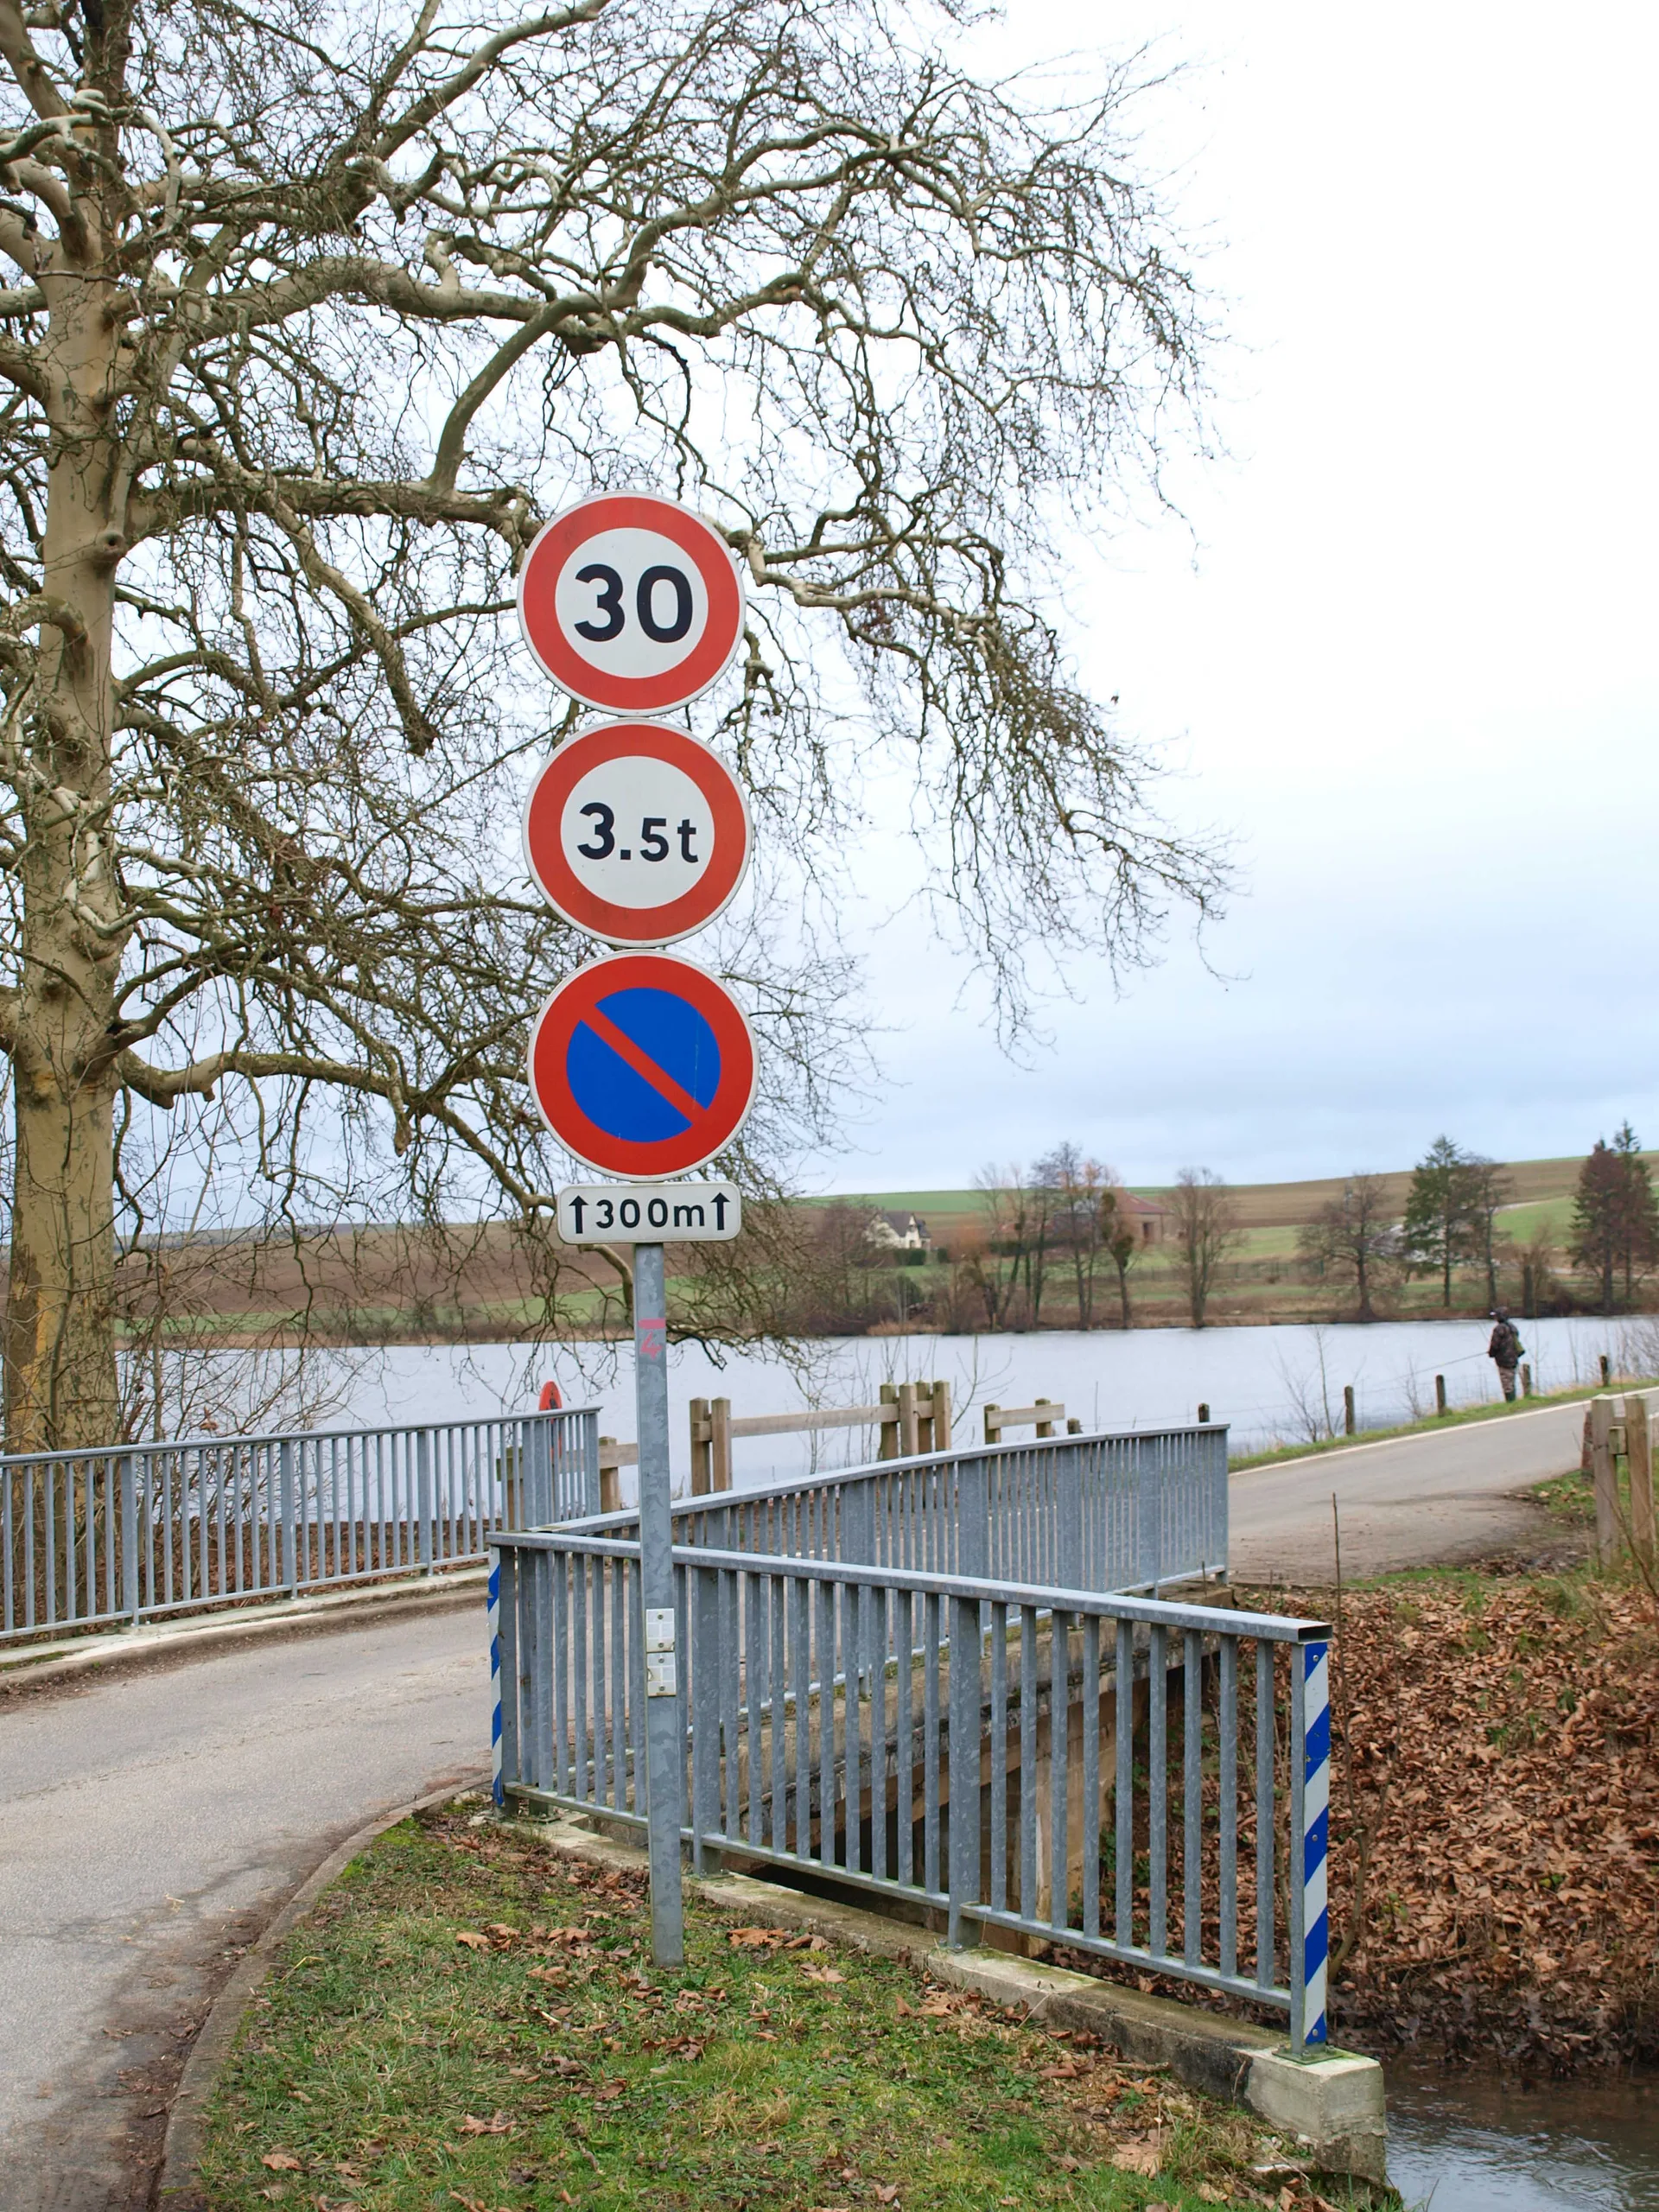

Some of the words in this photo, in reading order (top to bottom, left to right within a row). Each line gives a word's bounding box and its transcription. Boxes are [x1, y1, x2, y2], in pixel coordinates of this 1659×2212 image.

[574, 563, 693, 644] 30
[576, 802, 699, 864] 3.5t
[595, 1198, 705, 1230] 300m
